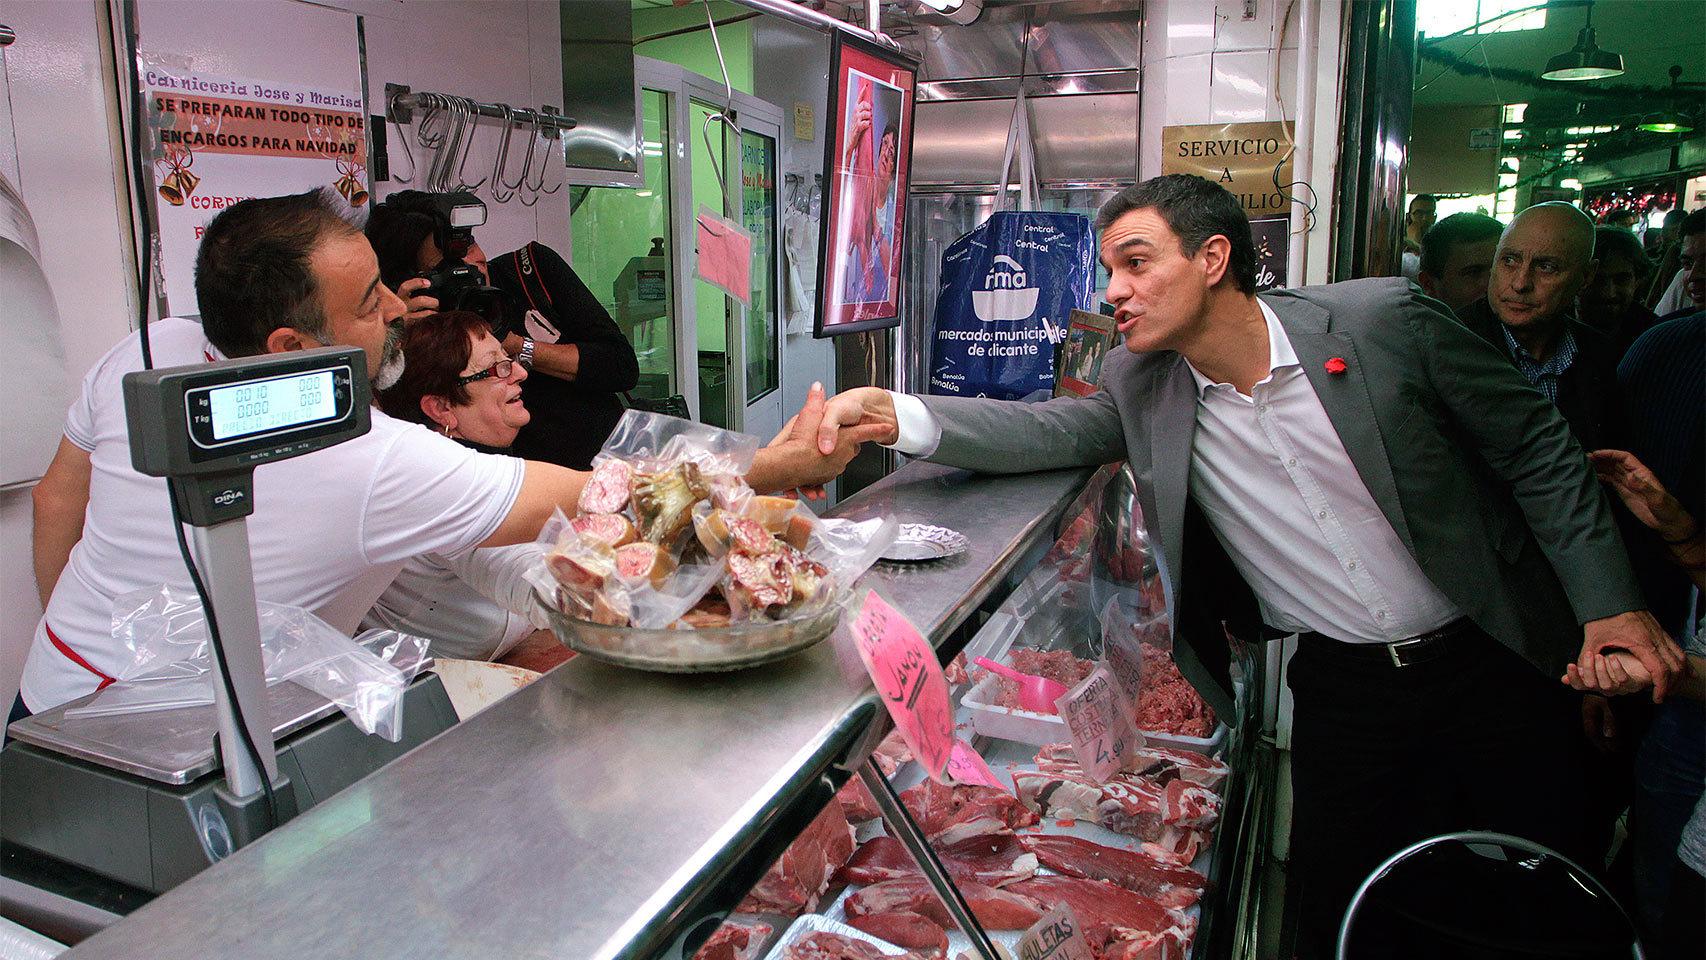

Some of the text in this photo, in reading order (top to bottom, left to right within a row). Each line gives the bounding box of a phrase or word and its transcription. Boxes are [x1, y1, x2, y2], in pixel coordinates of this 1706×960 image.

[296, 94, 305, 104] y
[310, 92, 363, 108] Marisa
[156, 98, 364, 130] SE PREPARAN TODO TIPO DE
[160, 129, 357, 154] ENCARGOS PARA NAVIDAD
[1178, 138, 1278, 157] SERVICIO
[1219, 168, 1234, 182] A
[1024, 225, 1054, 233] Central
[1016, 240, 1048, 252] Central
[968, 343, 984, 356] de
[199, 398, 208, 407] kg
[200, 414, 210, 422] kg
[214, 492, 244, 504] DINA
